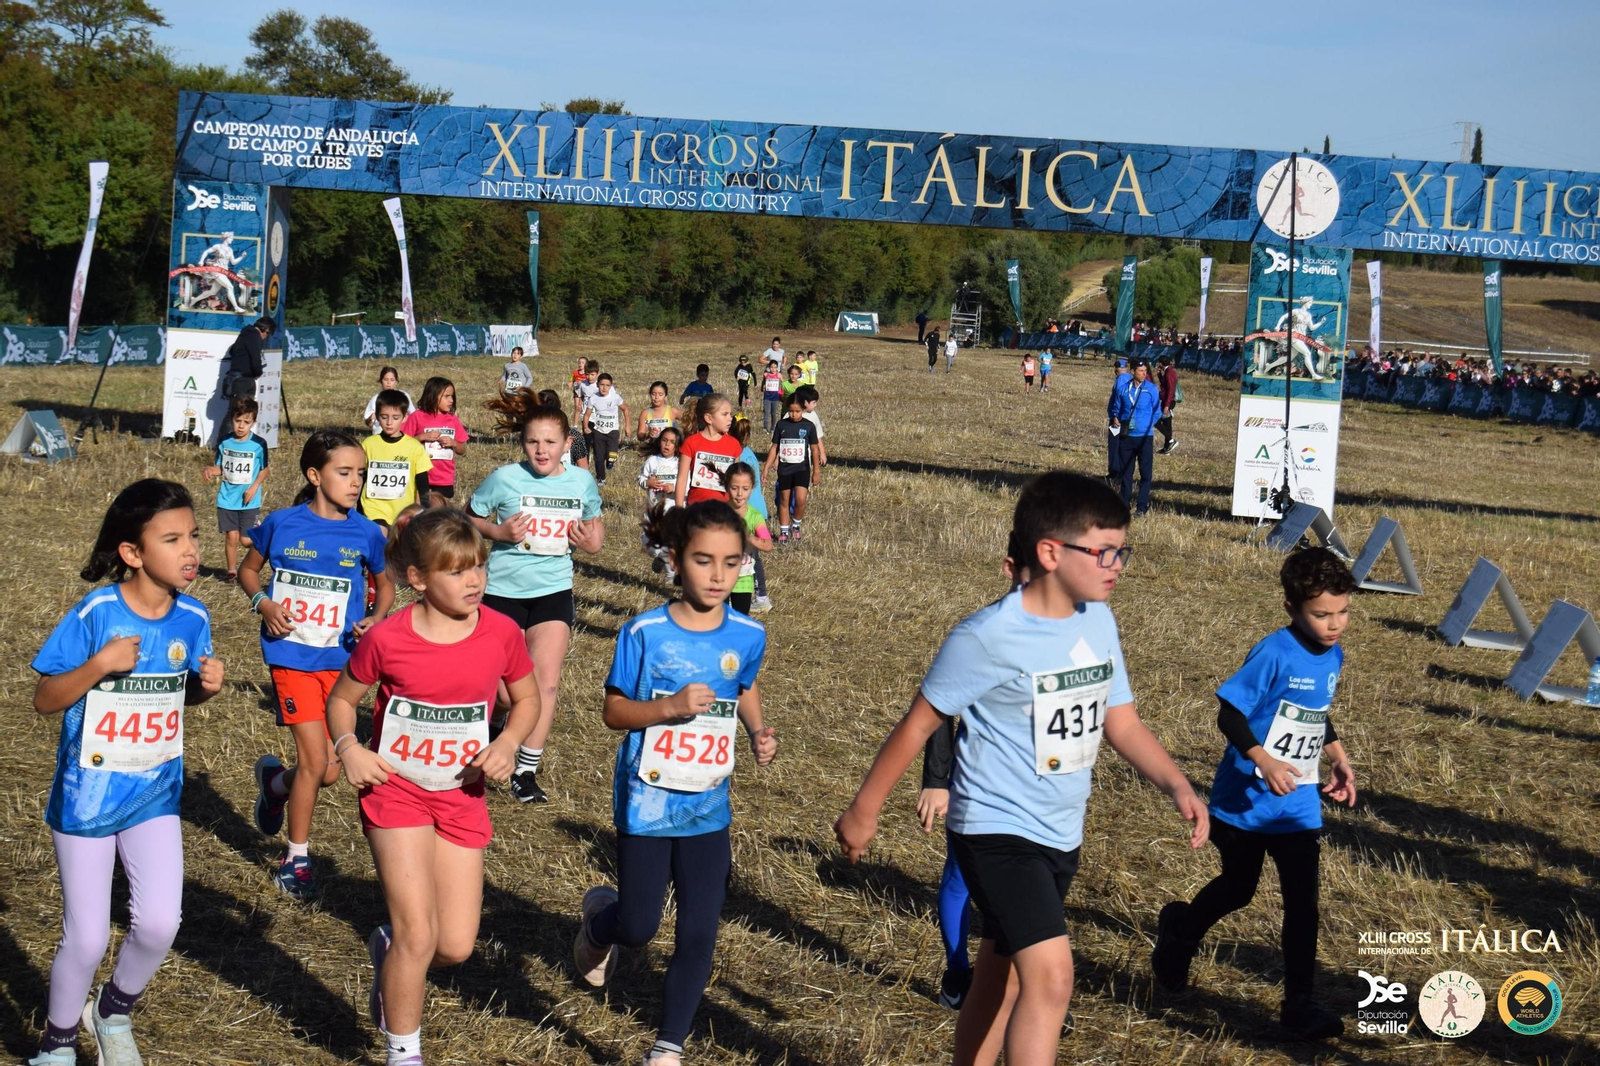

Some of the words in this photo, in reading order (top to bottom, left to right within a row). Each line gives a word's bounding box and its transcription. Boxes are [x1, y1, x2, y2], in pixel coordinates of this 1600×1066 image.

[193, 120, 301, 139] CAMPEONATO
[303, 127, 324, 140] DE
[327, 128, 420, 146] ANDALUCÍA
[228, 137, 250, 150] DE
[251, 138, 308, 153] CAMPO
[311, 142, 323, 154] A
[323, 142, 384, 158] TRAVÉS
[482, 122, 647, 184] XLIII
[651, 132, 780, 169] CROSS
[262, 153, 294, 167] POR
[296, 155, 352, 170] CLUBES
[650, 167, 825, 193] INTERNACIONAL
[837, 132, 1154, 217] ITÁLICA
[222, 193, 257, 202] Diputación
[480, 180, 634, 204] INTERNATIONAL
[639, 189, 697, 208] CROSS
[701, 191, 794, 212] COUNTRY
[1385, 171, 1559, 237] XLIII
[222, 201, 257, 212] Sevilla
[1383, 231, 1544, 258] INTERNATIONAL
[1302, 256, 1339, 266] Diputación
[1301, 264, 1338, 276] Sevilla
[782, 448, 804, 456] 4533
[224, 460, 250, 474] 4144
[372, 474, 406, 488] 4294
[284, 546, 318, 558] CÓDOMO
[295, 574, 332, 590] ITÁLICA
[122, 678, 170, 690] ITÁLICA
[1064, 669, 1104, 686] ITÁLICA
[416, 707, 465, 720] ITÁLICA
[94, 710, 180, 744] 4459
[390, 734, 481, 768] 4458
[654, 730, 730, 766] 4528
[1273, 732, 1324, 760] 4159
